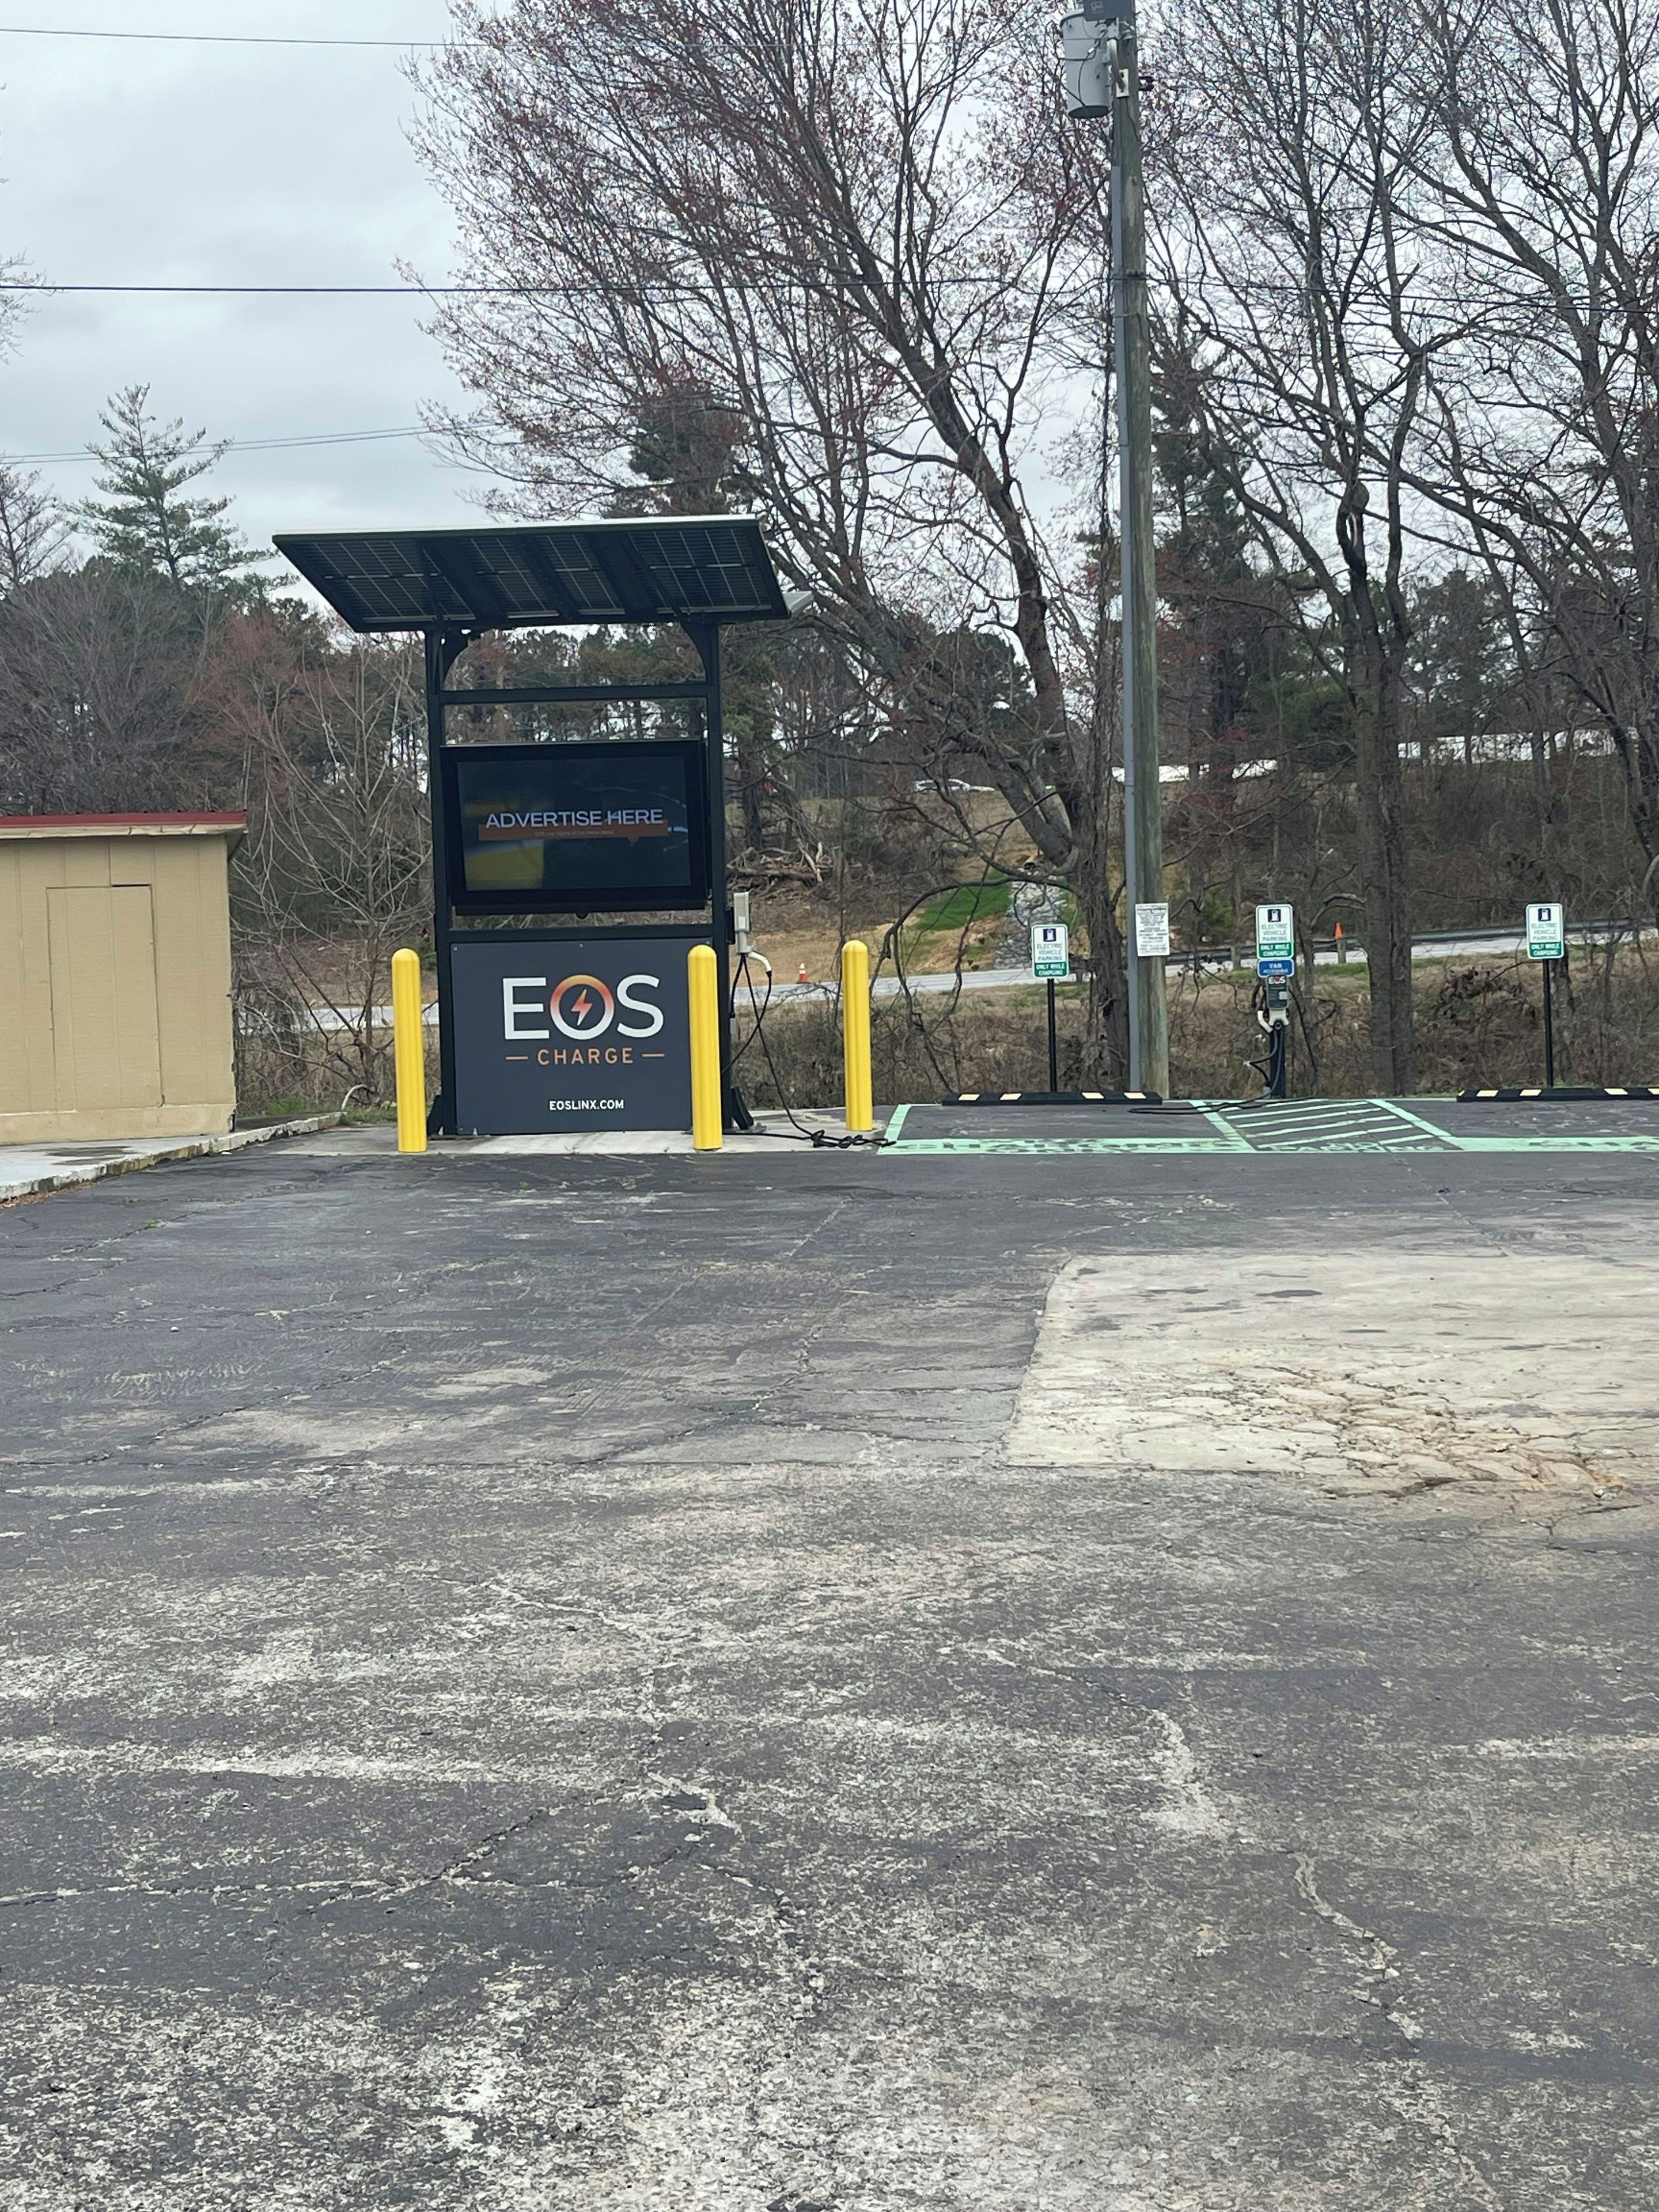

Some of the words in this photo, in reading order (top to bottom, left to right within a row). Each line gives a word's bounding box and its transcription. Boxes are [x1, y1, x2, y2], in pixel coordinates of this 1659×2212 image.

[486, 810, 602, 828] ADVERTISE
[607, 809, 663, 825] HERE
[1268, 976, 1286, 984] EOS
[503, 974, 664, 1040] EOS
[537, 1047, 634, 1065] CHARGE
[549, 1099, 624, 1111] EOSLINX.COM
